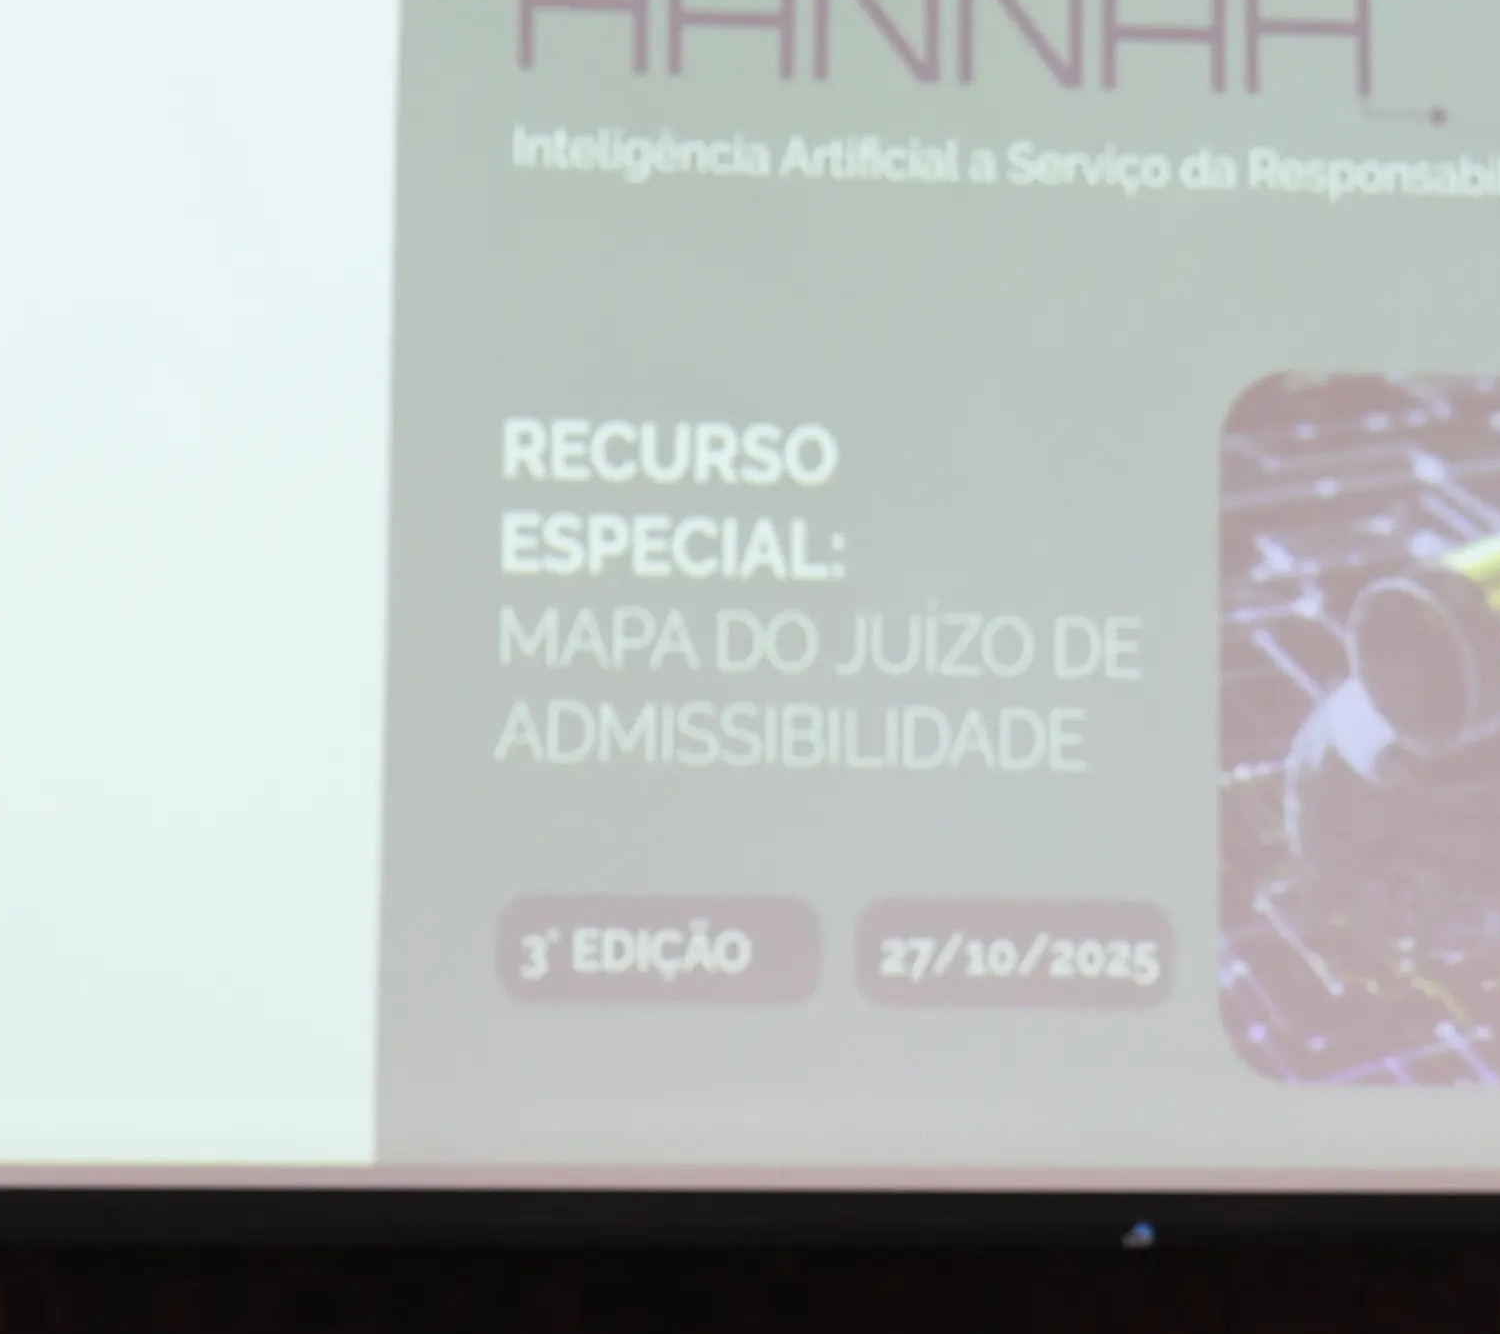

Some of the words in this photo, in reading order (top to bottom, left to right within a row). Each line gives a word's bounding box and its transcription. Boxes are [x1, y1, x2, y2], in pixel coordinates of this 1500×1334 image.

[513, 126, 771, 184] Inteligência
[781, 135, 960, 183] Artificial
[1006, 139, 1172, 197] Serviço
[1180, 150, 1237, 190] da
[504, 419, 838, 484] RECURSO
[502, 512, 844, 580] ESPECIAL:
[499, 605, 699, 670] MAPA
[716, 609, 820, 674] DO
[835, 599, 1036, 678] JUÍZO
[1054, 616, 1142, 680] DE
[494, 700, 1087, 772] ADMISSIBILIDADE
[572, 920, 752, 980] EDIÇÃO
[880, 933, 1161, 986] 27/10/2025
